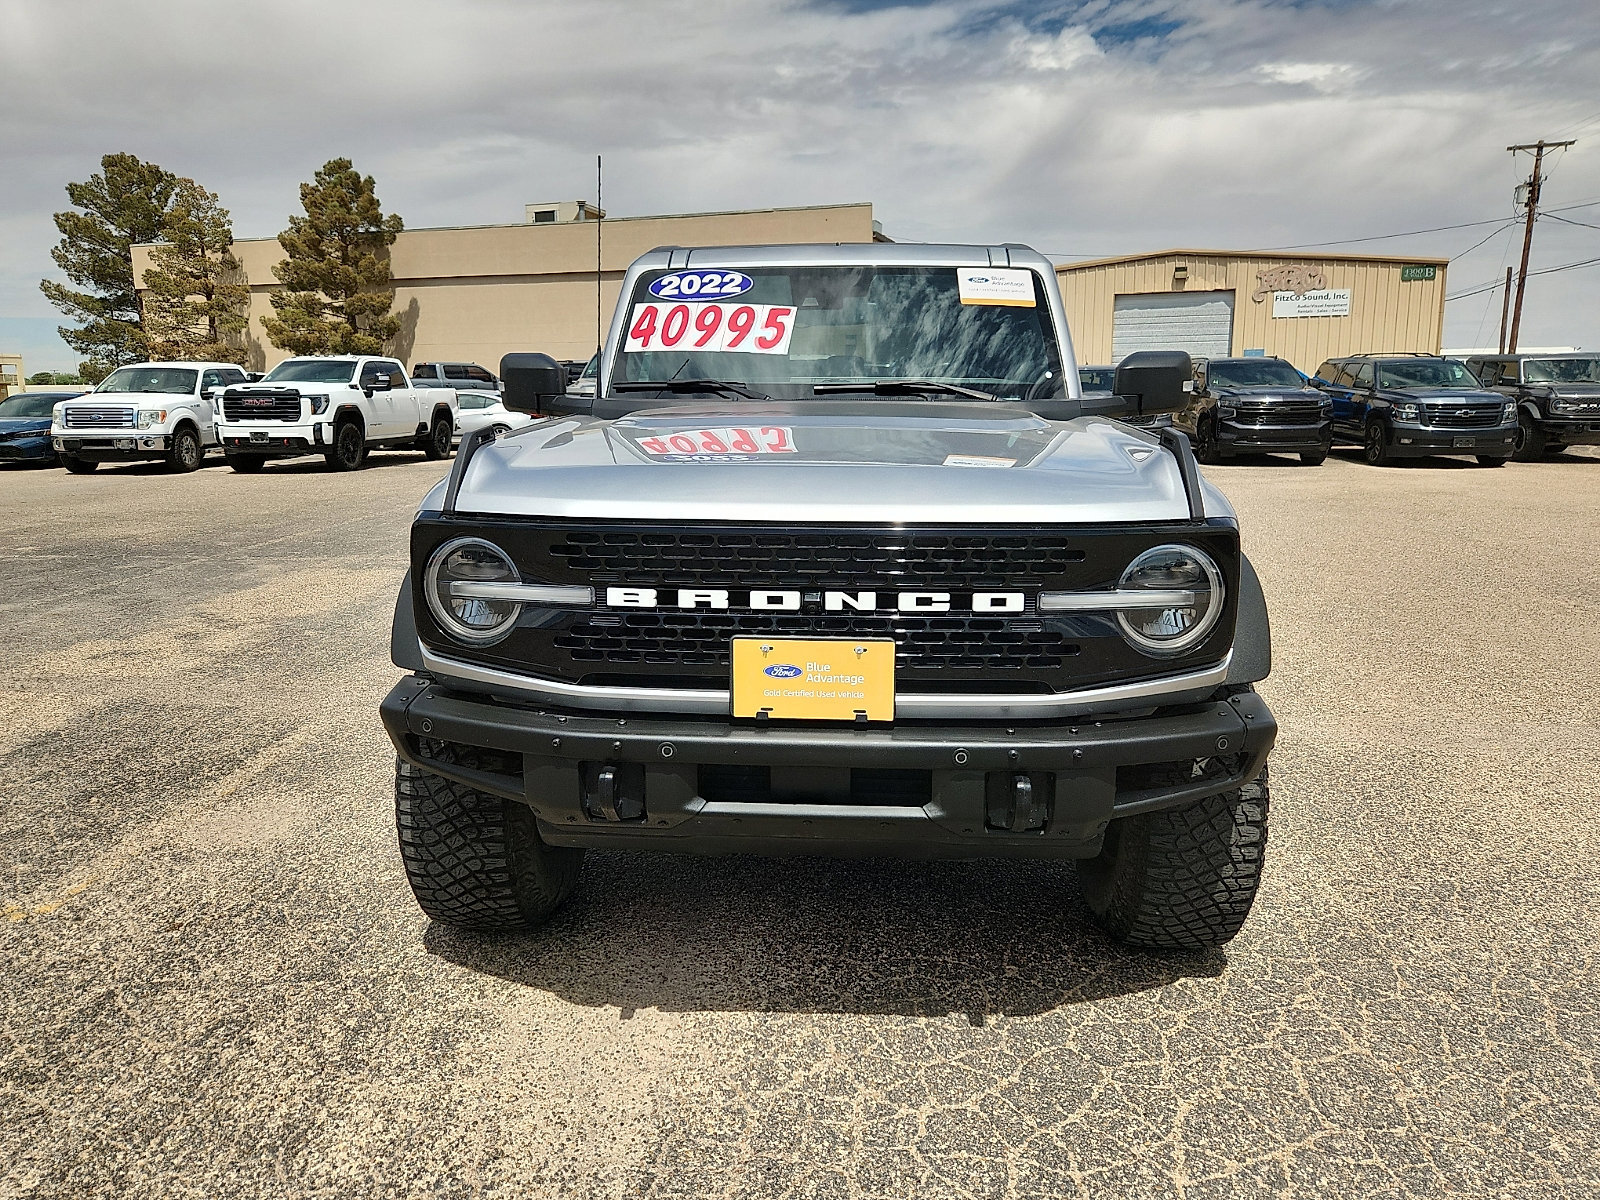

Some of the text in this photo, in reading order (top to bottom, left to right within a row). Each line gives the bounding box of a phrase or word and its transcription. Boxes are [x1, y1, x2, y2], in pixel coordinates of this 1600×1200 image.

[1425, 267, 1434, 277] B
[659, 273, 743, 296] 2022
[1275, 292, 1348, 302] FitzCo Sound, Inc.
[630, 304, 791, 350] 40995
[606, 586, 1025, 613] BRONCO
[768, 665, 799, 678] Ford
[806, 662, 831, 672] Blue
[805, 673, 865, 686] Advantage
[763, 689, 781, 697] Gold
[783, 690, 814, 698] Certified
[816, 690, 836, 698] Used
